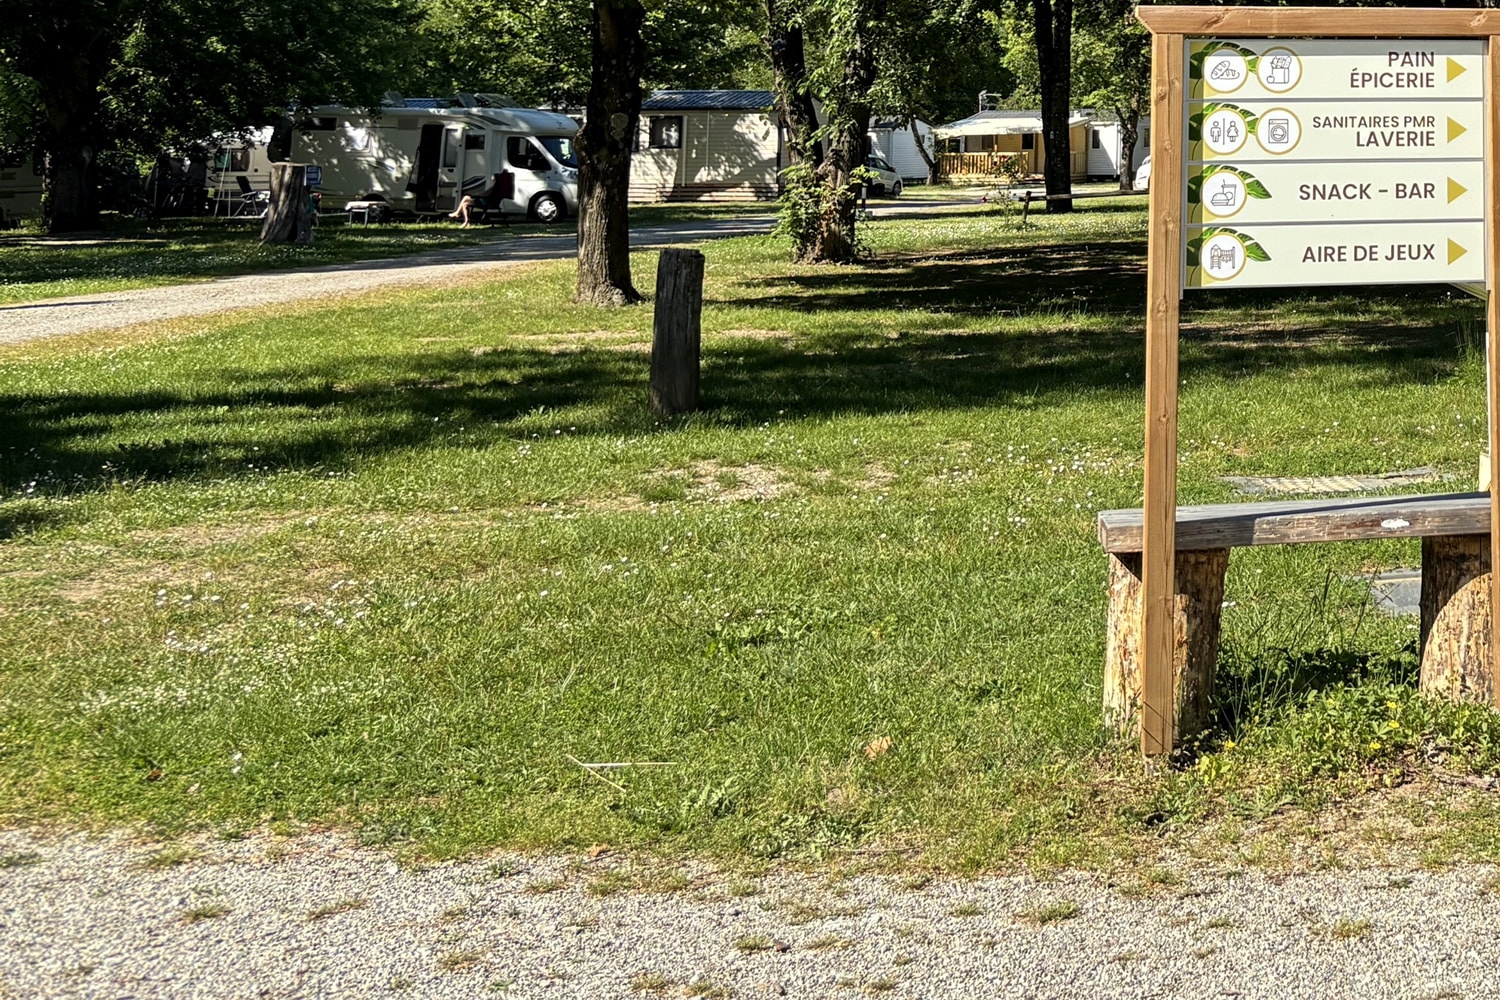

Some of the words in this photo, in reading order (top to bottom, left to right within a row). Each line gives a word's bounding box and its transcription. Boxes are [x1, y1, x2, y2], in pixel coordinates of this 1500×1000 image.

[1388, 51, 1435, 67] PAIN
[1350, 67, 1435, 88] ÉPICERIE
[1312, 115, 1400, 129] SANITAIRES
[1403, 115, 1436, 128] PMR
[1356, 130, 1436, 147] LAVERIE
[1299, 183, 1372, 201] SNACK
[1395, 182, 1436, 199] BAR
[1301, 245, 1347, 263] AIRE
[1353, 245, 1379, 262] DE
[1384, 243, 1436, 261] JEUX
